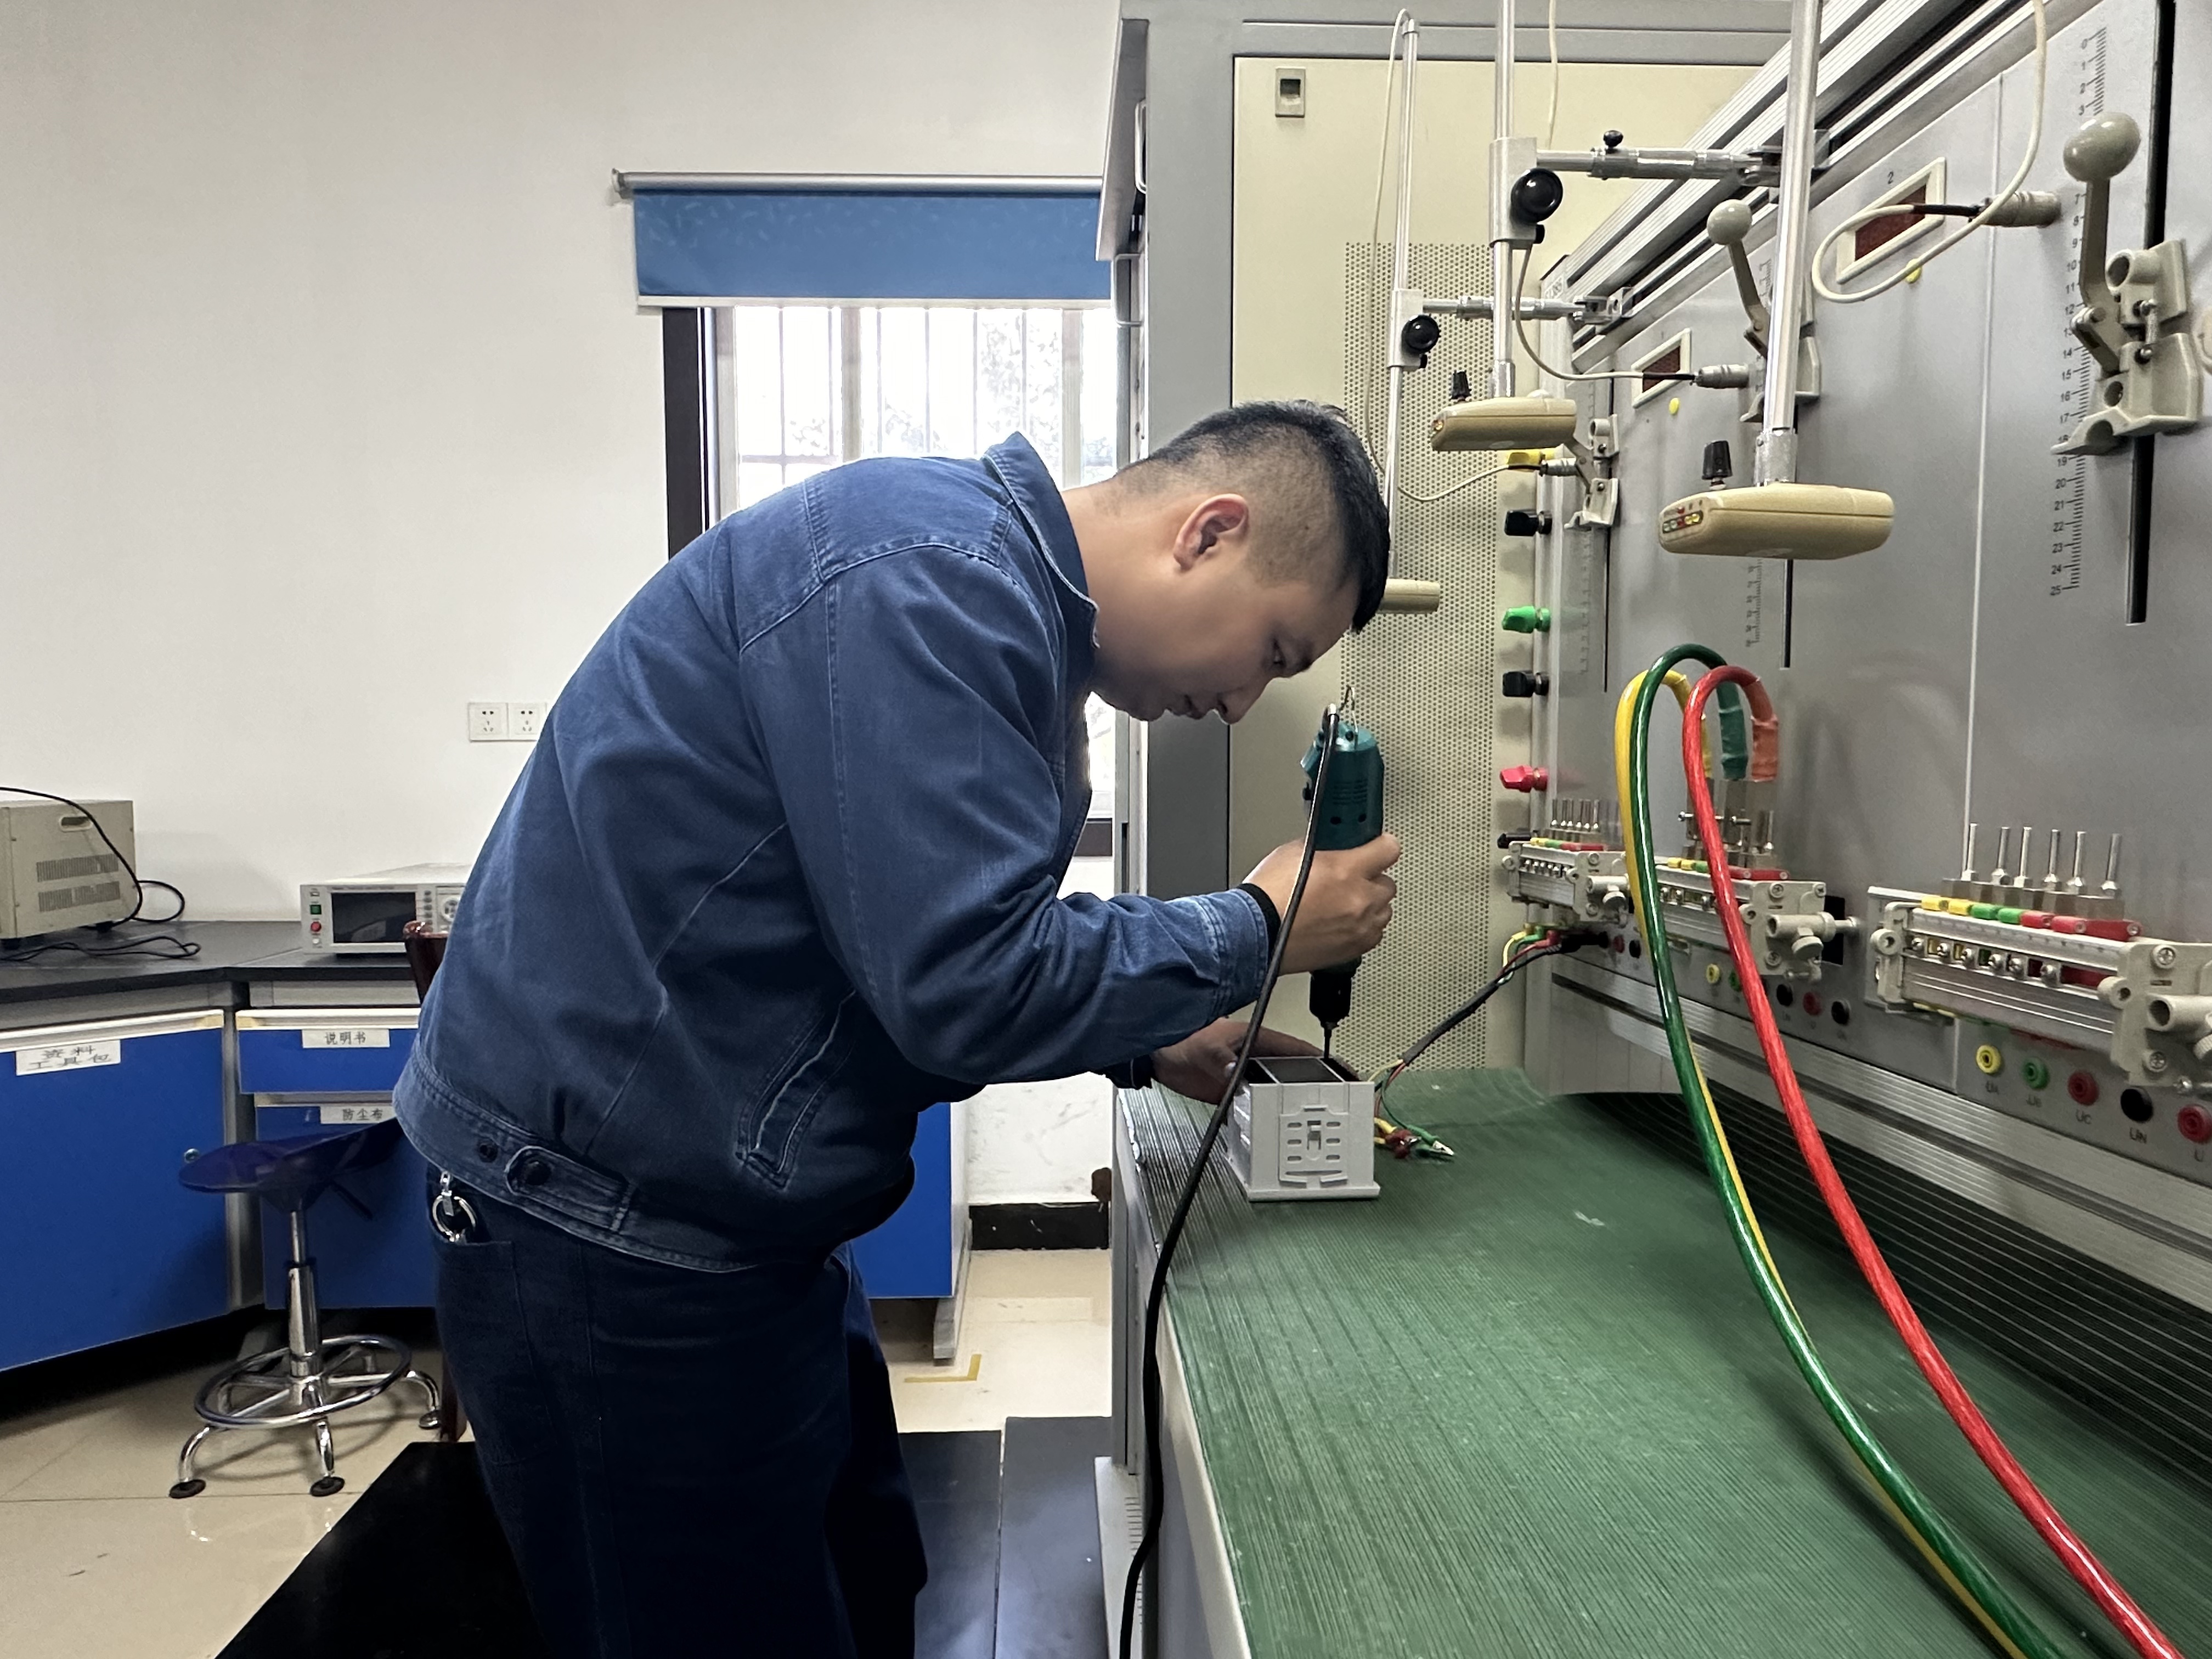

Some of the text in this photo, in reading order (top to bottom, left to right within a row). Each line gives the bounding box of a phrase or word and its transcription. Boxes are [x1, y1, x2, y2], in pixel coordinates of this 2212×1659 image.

[1888, 171, 1894, 184] 2
[2072, 238, 2078, 248] 9
[2067, 259, 2076, 272] 10
[2066, 282, 2074, 294] 11
[2065, 304, 2075, 315] 12
[2063, 347, 2072, 359] 14
[2062, 369, 2072, 381] 15
[2061, 391, 2070, 402] 16
[2060, 413, 2069, 424] 17
[2057, 456, 2067, 467] 19
[2055, 478, 2066, 489] 20
[2054, 500, 2064, 511] 21
[2053, 521, 2063, 532] 22
[2052, 543, 2063, 554] 23
[2051, 565, 2062, 575] 24
[2050, 585, 2061, 596] 25
[325, 1031, 366, 1045] 说明书
[342, 1108, 383, 1121] 防尘布
